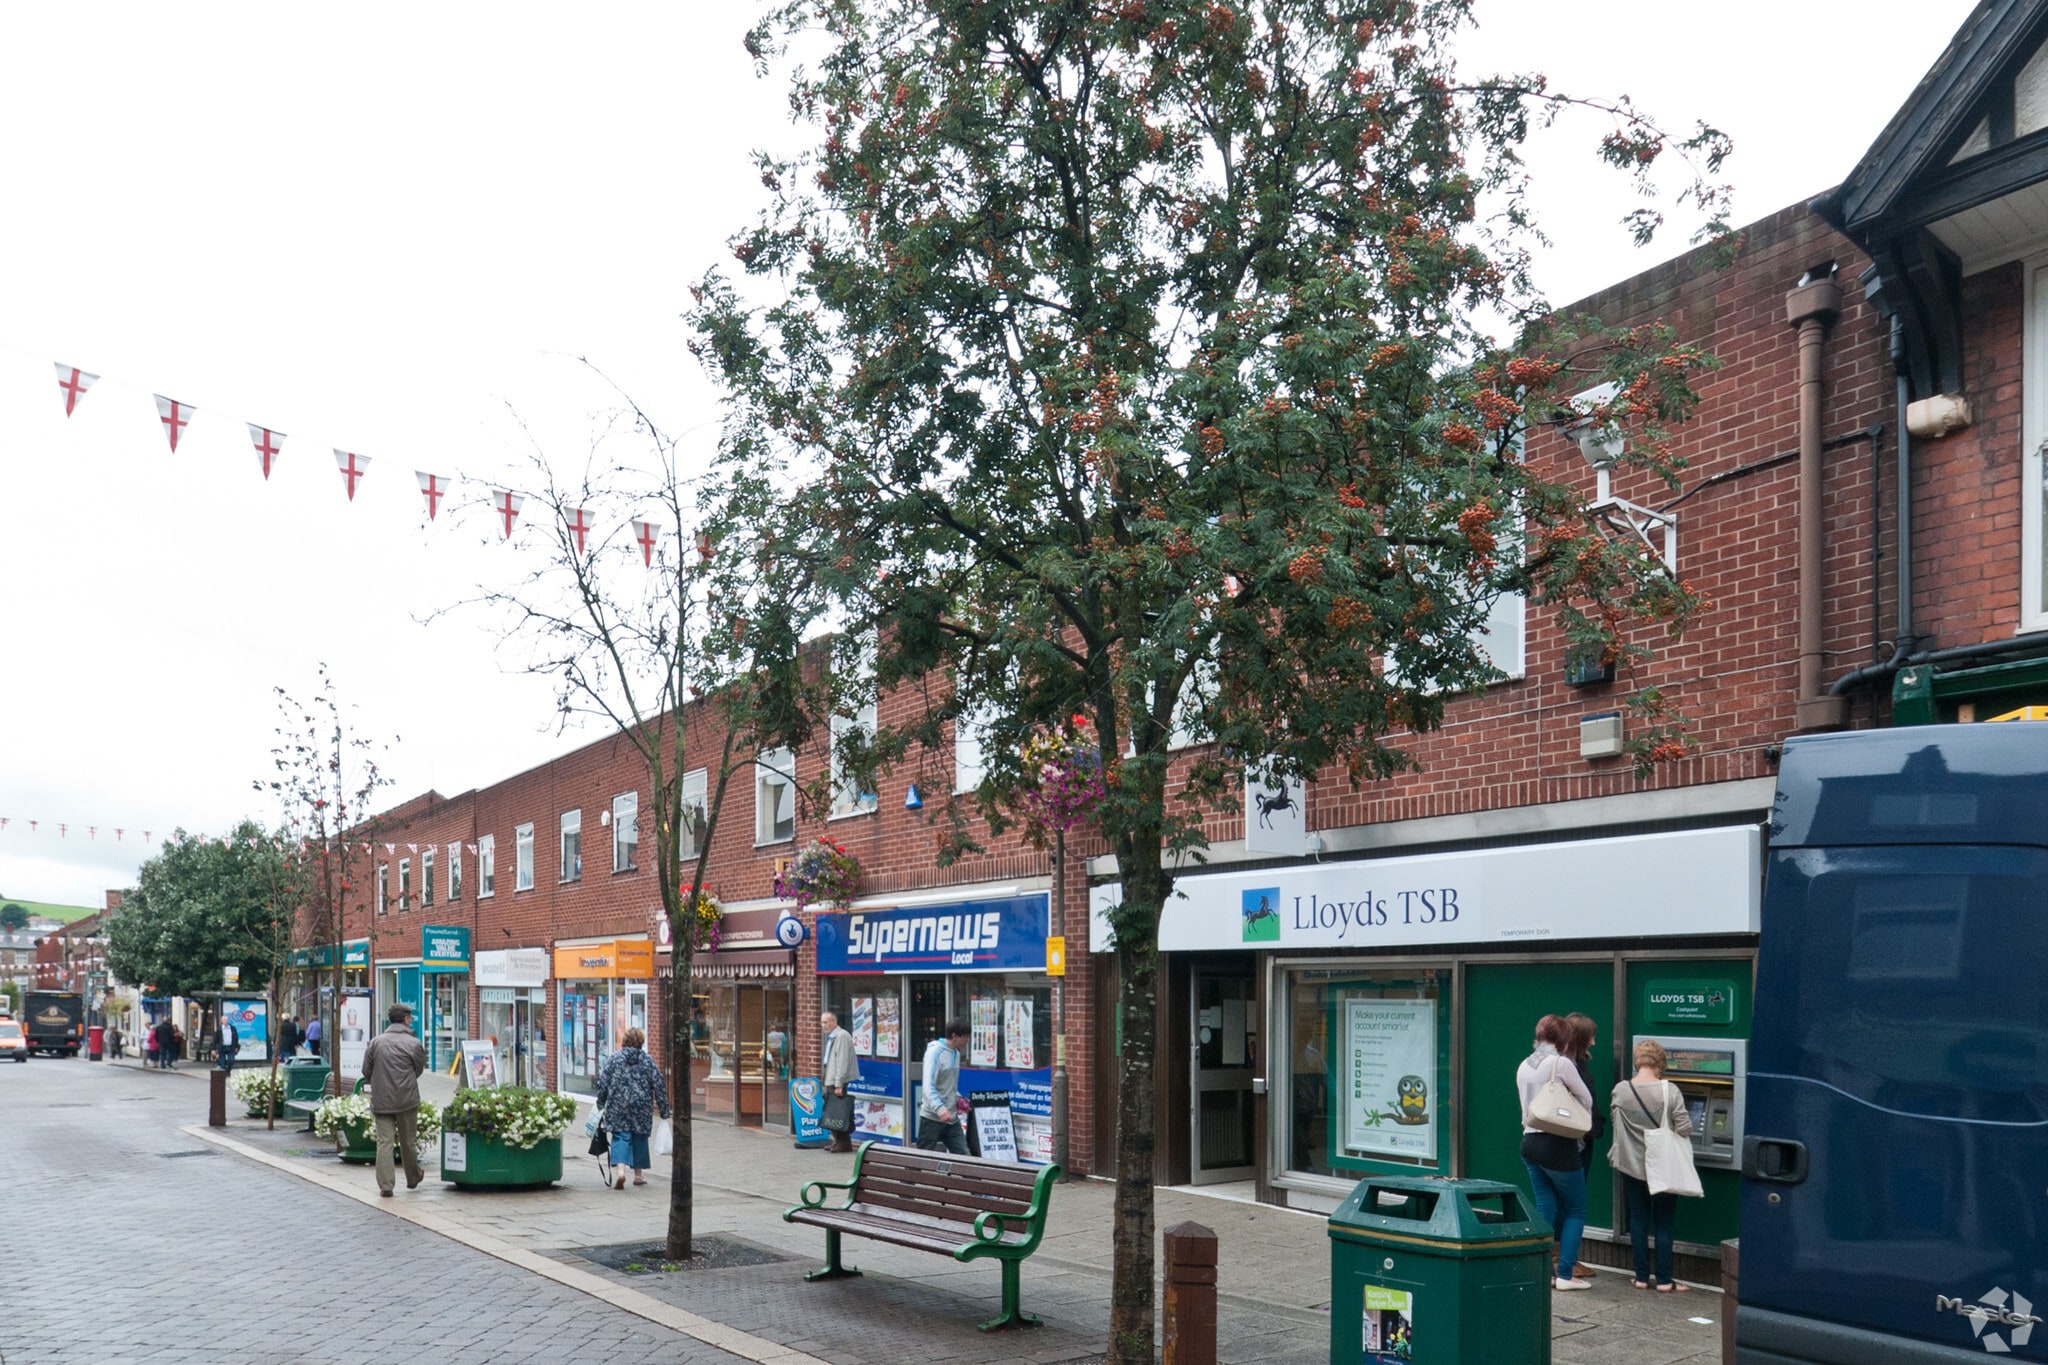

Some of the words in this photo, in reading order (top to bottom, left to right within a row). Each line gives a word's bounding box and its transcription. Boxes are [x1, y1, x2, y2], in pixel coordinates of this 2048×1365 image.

[1293, 890, 1388, 939] Lloyds
[1397, 888, 1459, 924] TSB
[847, 911, 1000, 963] Supernews
[951, 951, 973, 965] Local
[1650, 994, 1685, 1003] LLOYDS
[1687, 995, 1705, 1004] TSB
[1354, 1010, 1374, 1020] Make
[1375, 1012, 1389, 1021] your
[1390, 1011, 1416, 1020] current
[1354, 1022, 1381, 1030] account
[801, 1117, 819, 1128] Play
[800, 1128, 823, 1137] here!
[1936, 1294, 2044, 1329] Master
